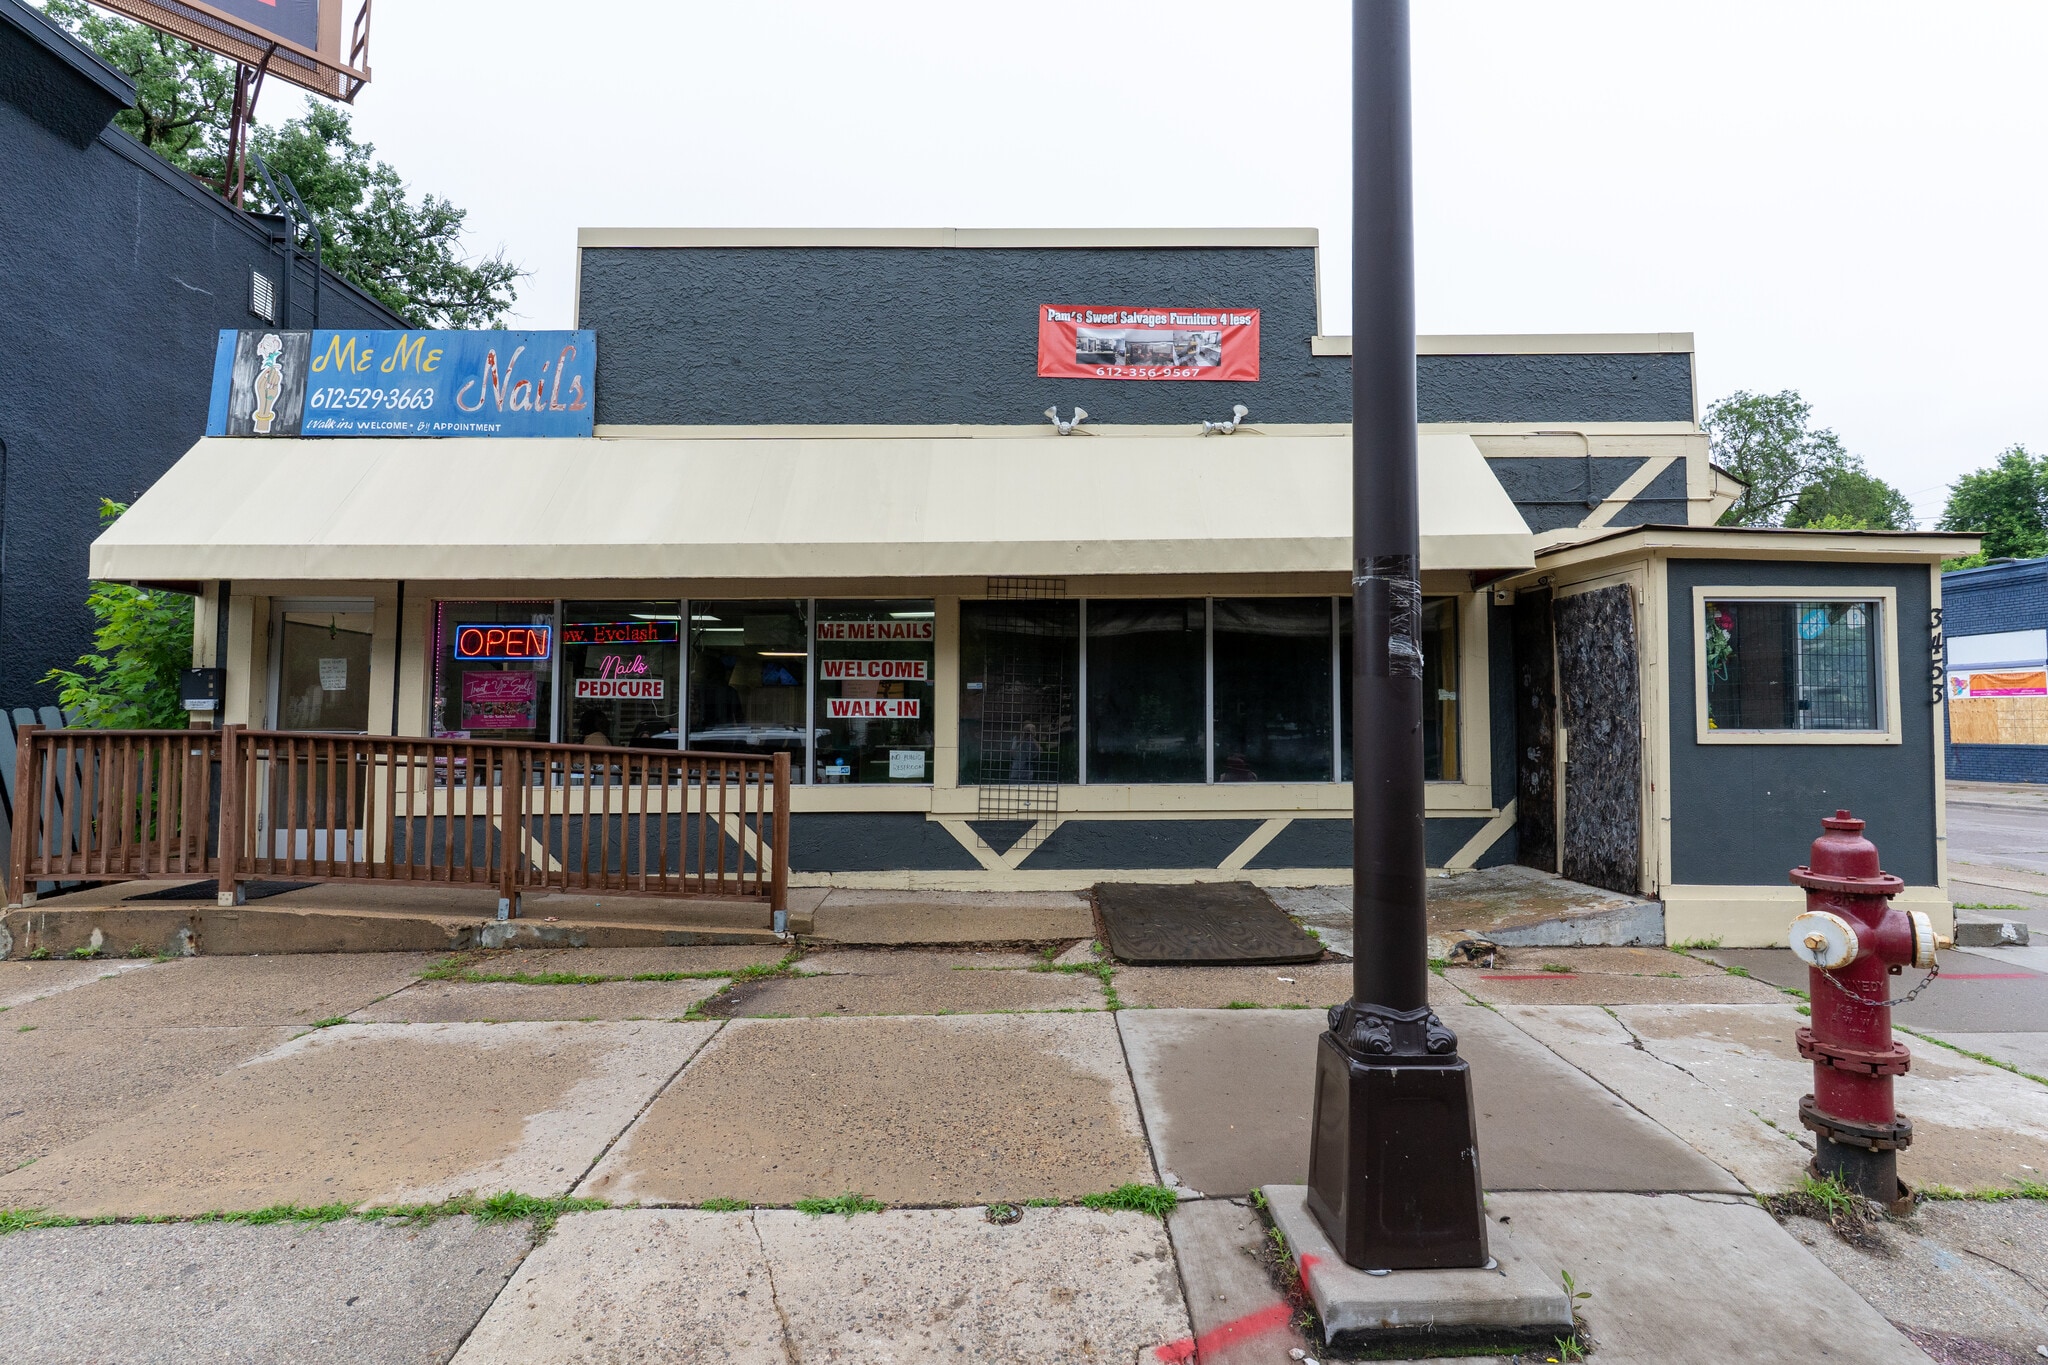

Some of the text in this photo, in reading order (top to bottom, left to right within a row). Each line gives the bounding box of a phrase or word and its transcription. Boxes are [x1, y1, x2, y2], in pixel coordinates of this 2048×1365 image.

[1047, 308, 1252, 327] Pam's Sweet Salvages Furniture 4 less
[1096, 367, 1201, 378] 612-356-9567
[357, 421, 408, 431] WELCOME
[433, 423, 501, 433] APPOINTMENT
[460, 629, 548, 656] OPEN
[599, 654, 649, 680] Nails
[824, 661, 925, 678] WELCOME
[577, 681, 662, 697] PEDICURE
[831, 701, 917, 717] WALK-IN
